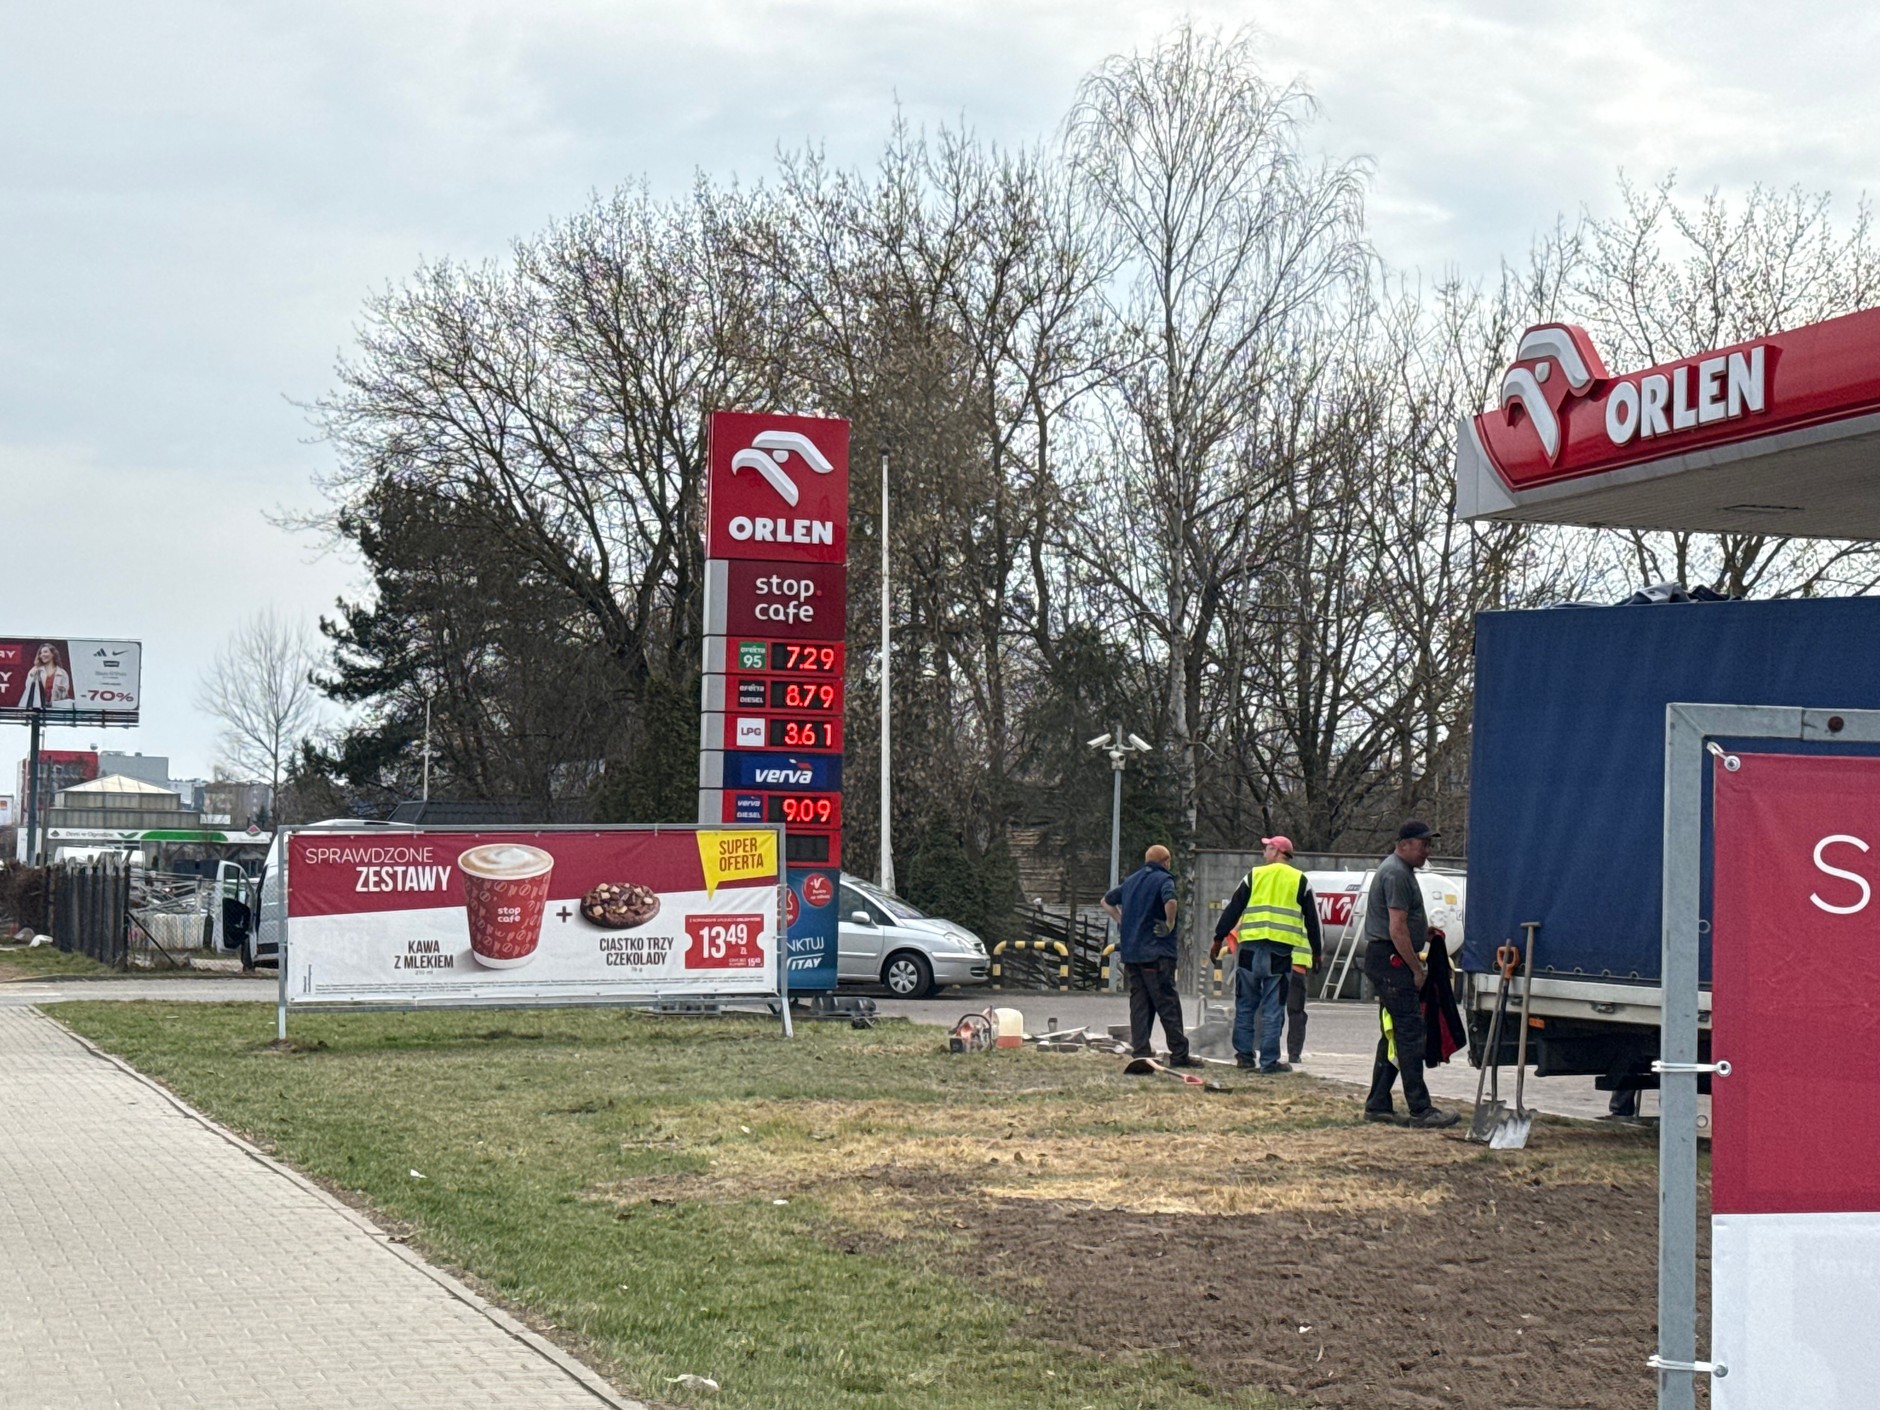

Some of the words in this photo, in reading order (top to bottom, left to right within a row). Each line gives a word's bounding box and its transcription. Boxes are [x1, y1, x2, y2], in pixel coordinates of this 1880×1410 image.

[1605, 345, 1766, 447] ORLEN
[729, 516, 833, 545] ORLEN
[755, 575, 814, 602] stop
[755, 601, 814, 624] cafe
[743, 655, 763, 668] 95
[80, 690, 134, 702] -70%
[740, 727, 761, 736] LPG
[755, 768, 813, 784] verva
[736, 811, 761, 819] DIESEL
[719, 837, 758, 855] SUPER
[305, 847, 434, 864] SPRAWDZONE
[719, 853, 764, 872] OFERTA
[355, 865, 452, 892] ZESTAWY
[1809, 834, 1871, 915] S
[497, 906, 521, 915] stop
[497, 914, 521, 923] cafe
[408, 940, 440, 954] KAWA
[600, 937, 644, 952] CIASTKO
[646, 937, 674, 951] TRZY
[394, 955, 402, 969] Z
[403, 954, 454, 969] MLEKIEM
[606, 951, 668, 967] CZEKOLADY
